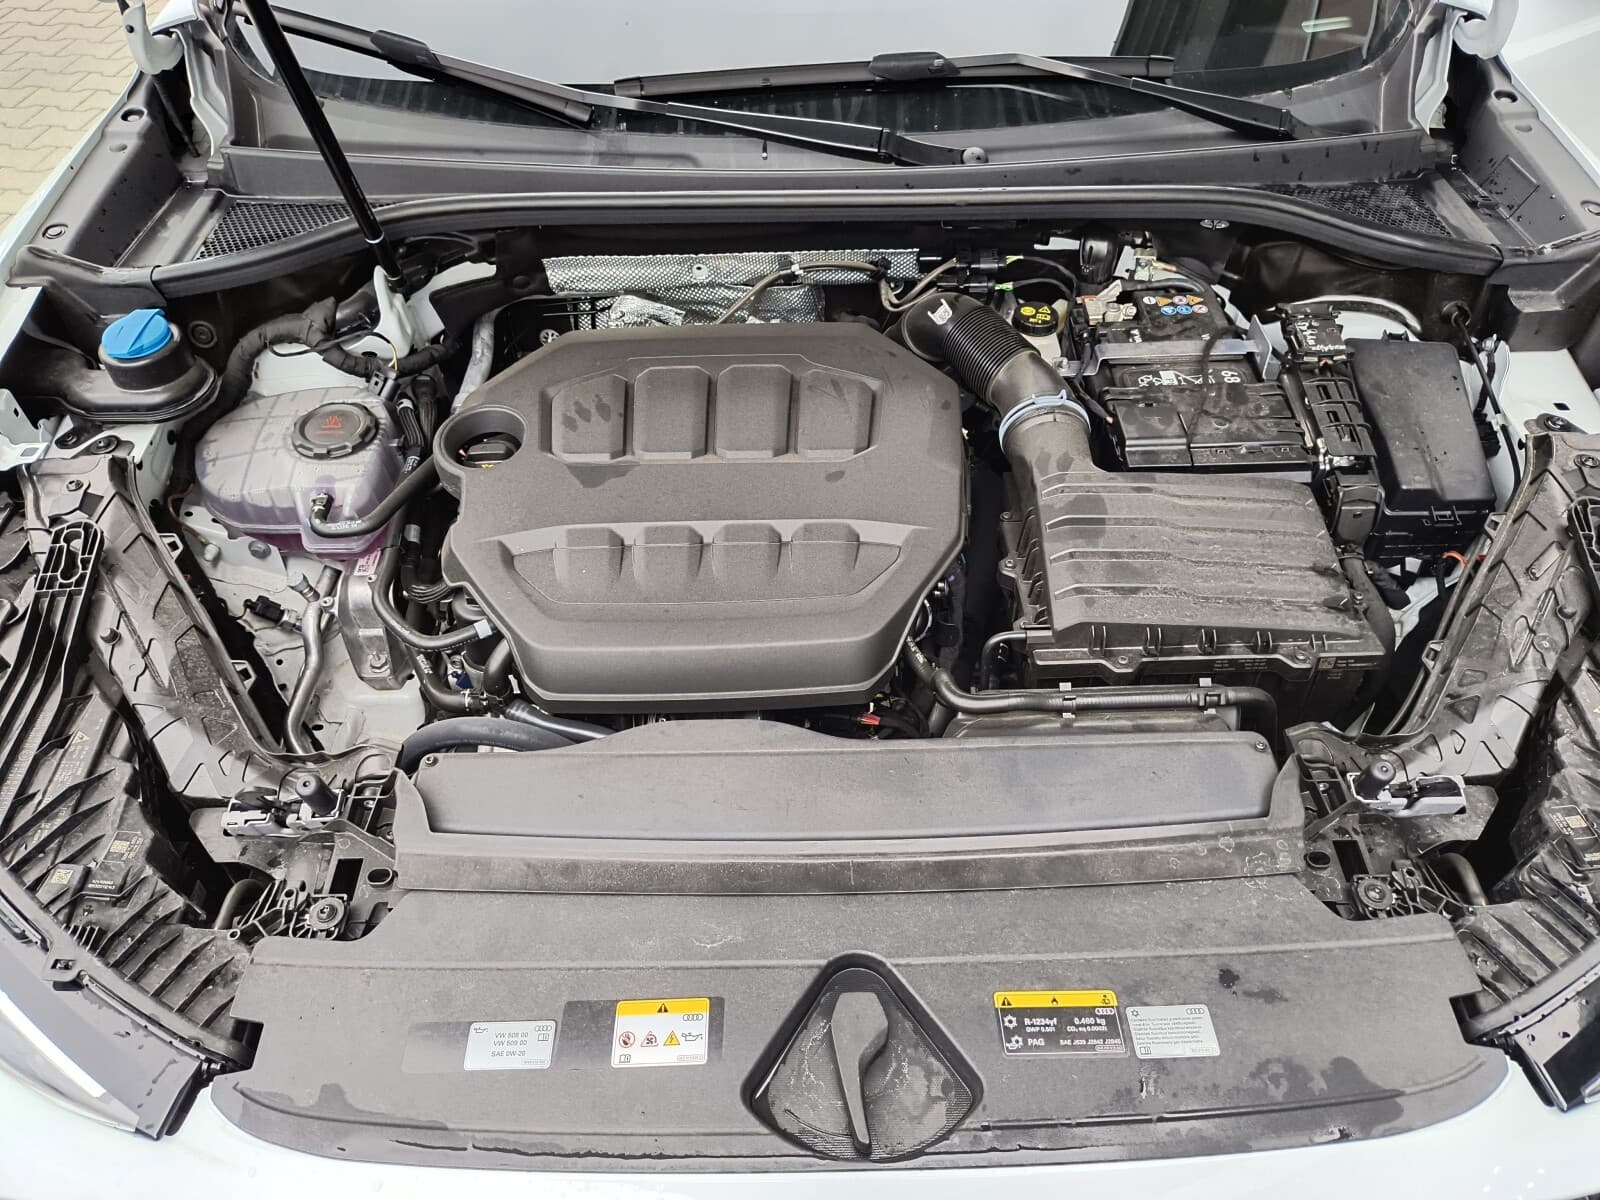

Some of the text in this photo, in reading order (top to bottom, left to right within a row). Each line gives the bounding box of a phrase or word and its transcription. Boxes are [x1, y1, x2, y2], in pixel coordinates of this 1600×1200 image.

[1024, 1017, 1057, 1026] R-1234yf
[1096, 1017, 1106, 1026] kg
[1027, 1038, 1046, 1046] PAG
